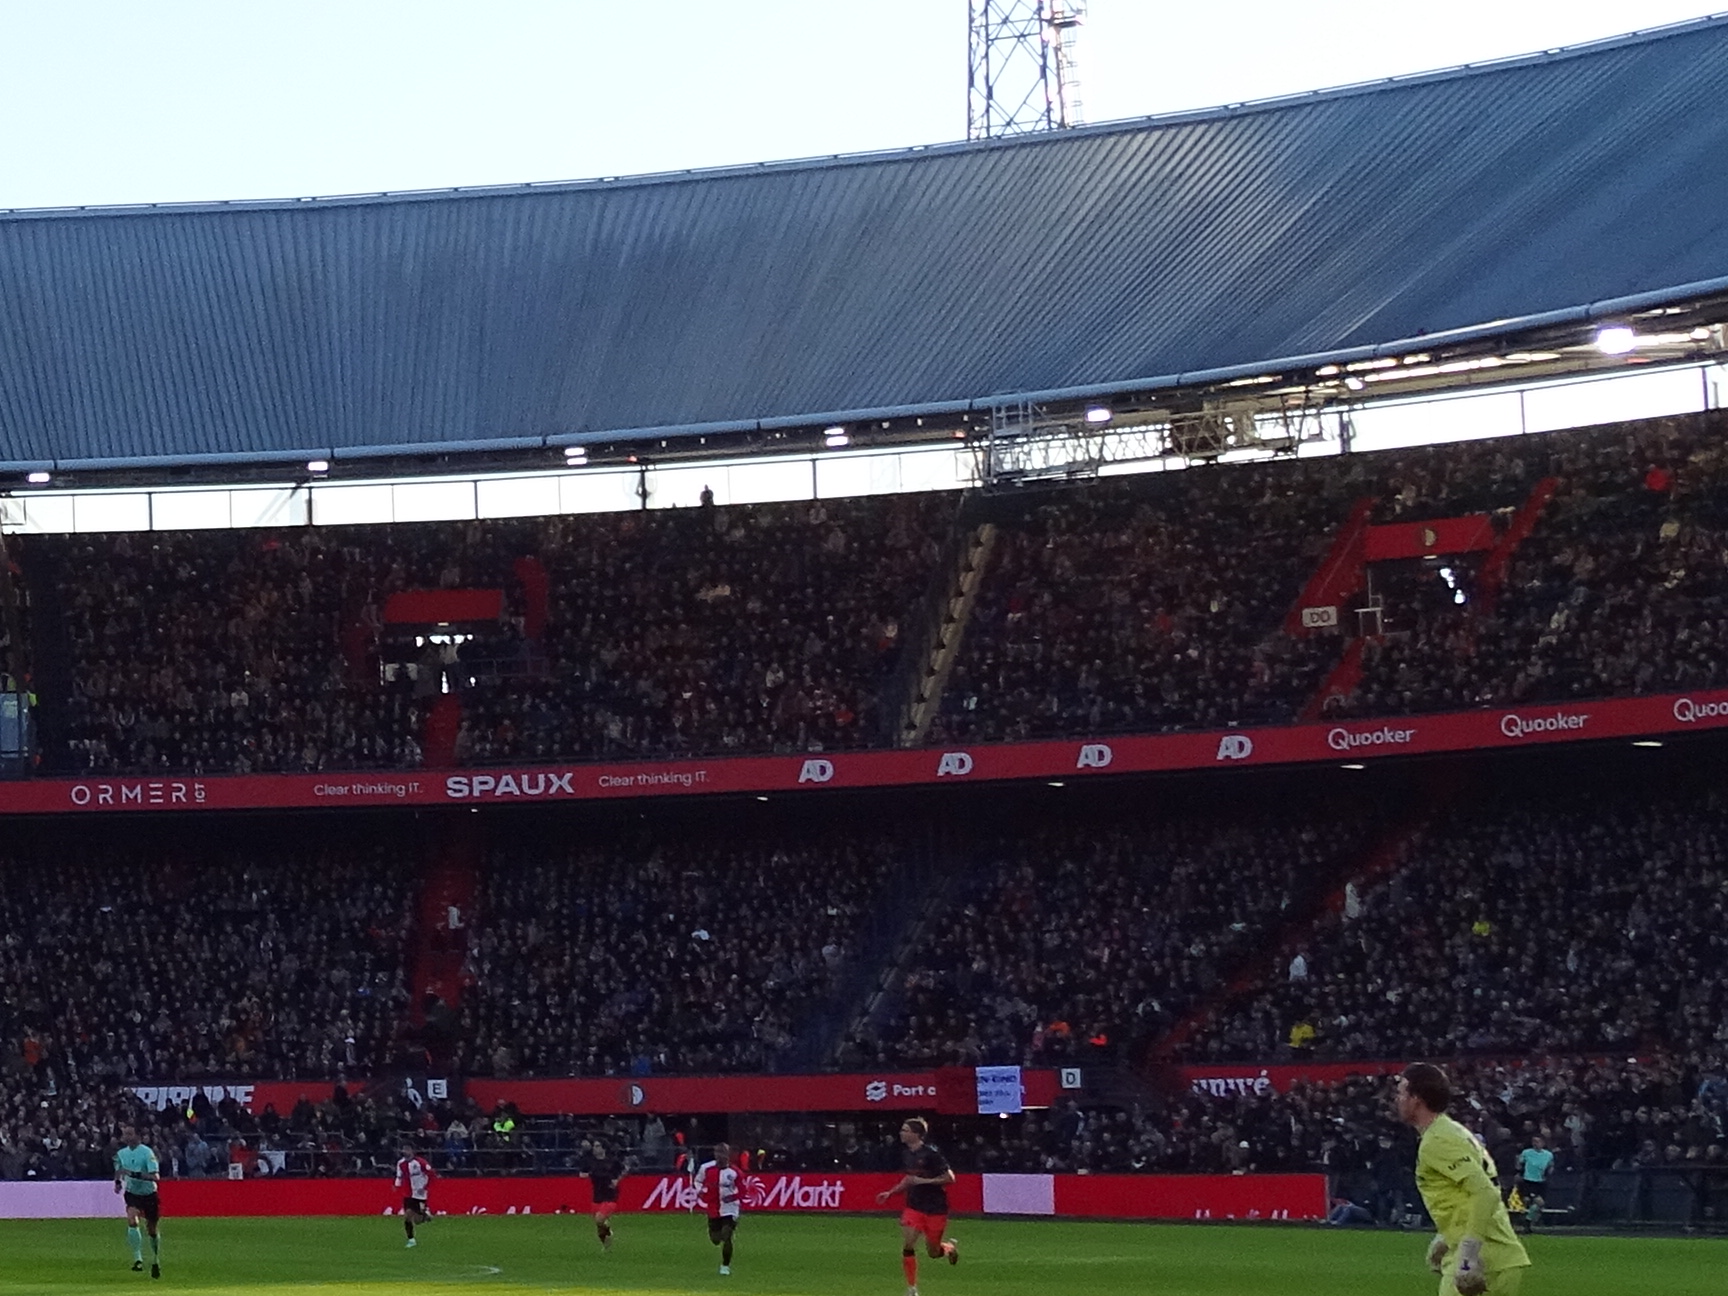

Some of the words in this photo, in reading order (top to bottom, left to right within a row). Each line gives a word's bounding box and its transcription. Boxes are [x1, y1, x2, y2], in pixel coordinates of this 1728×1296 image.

[1500, 711, 1591, 737] Quooker
[1216, 734, 1253, 761] AD
[1327, 726, 1415, 750] Quooker
[937, 751, 974, 777] AD
[1076, 743, 1113, 769] AD
[598, 774, 635, 788] Clear
[637, 772, 692, 787] thinking
[798, 759, 834, 784] AD
[71, 782, 187, 805] ORMER
[313, 783, 349, 796] Clear
[352, 782, 406, 797] thinking
[446, 772, 575, 798] SPAUX
[433, 1083, 442, 1094] E
[1065, 1072, 1076, 1084] D
[763, 1175, 845, 1207] Markt
